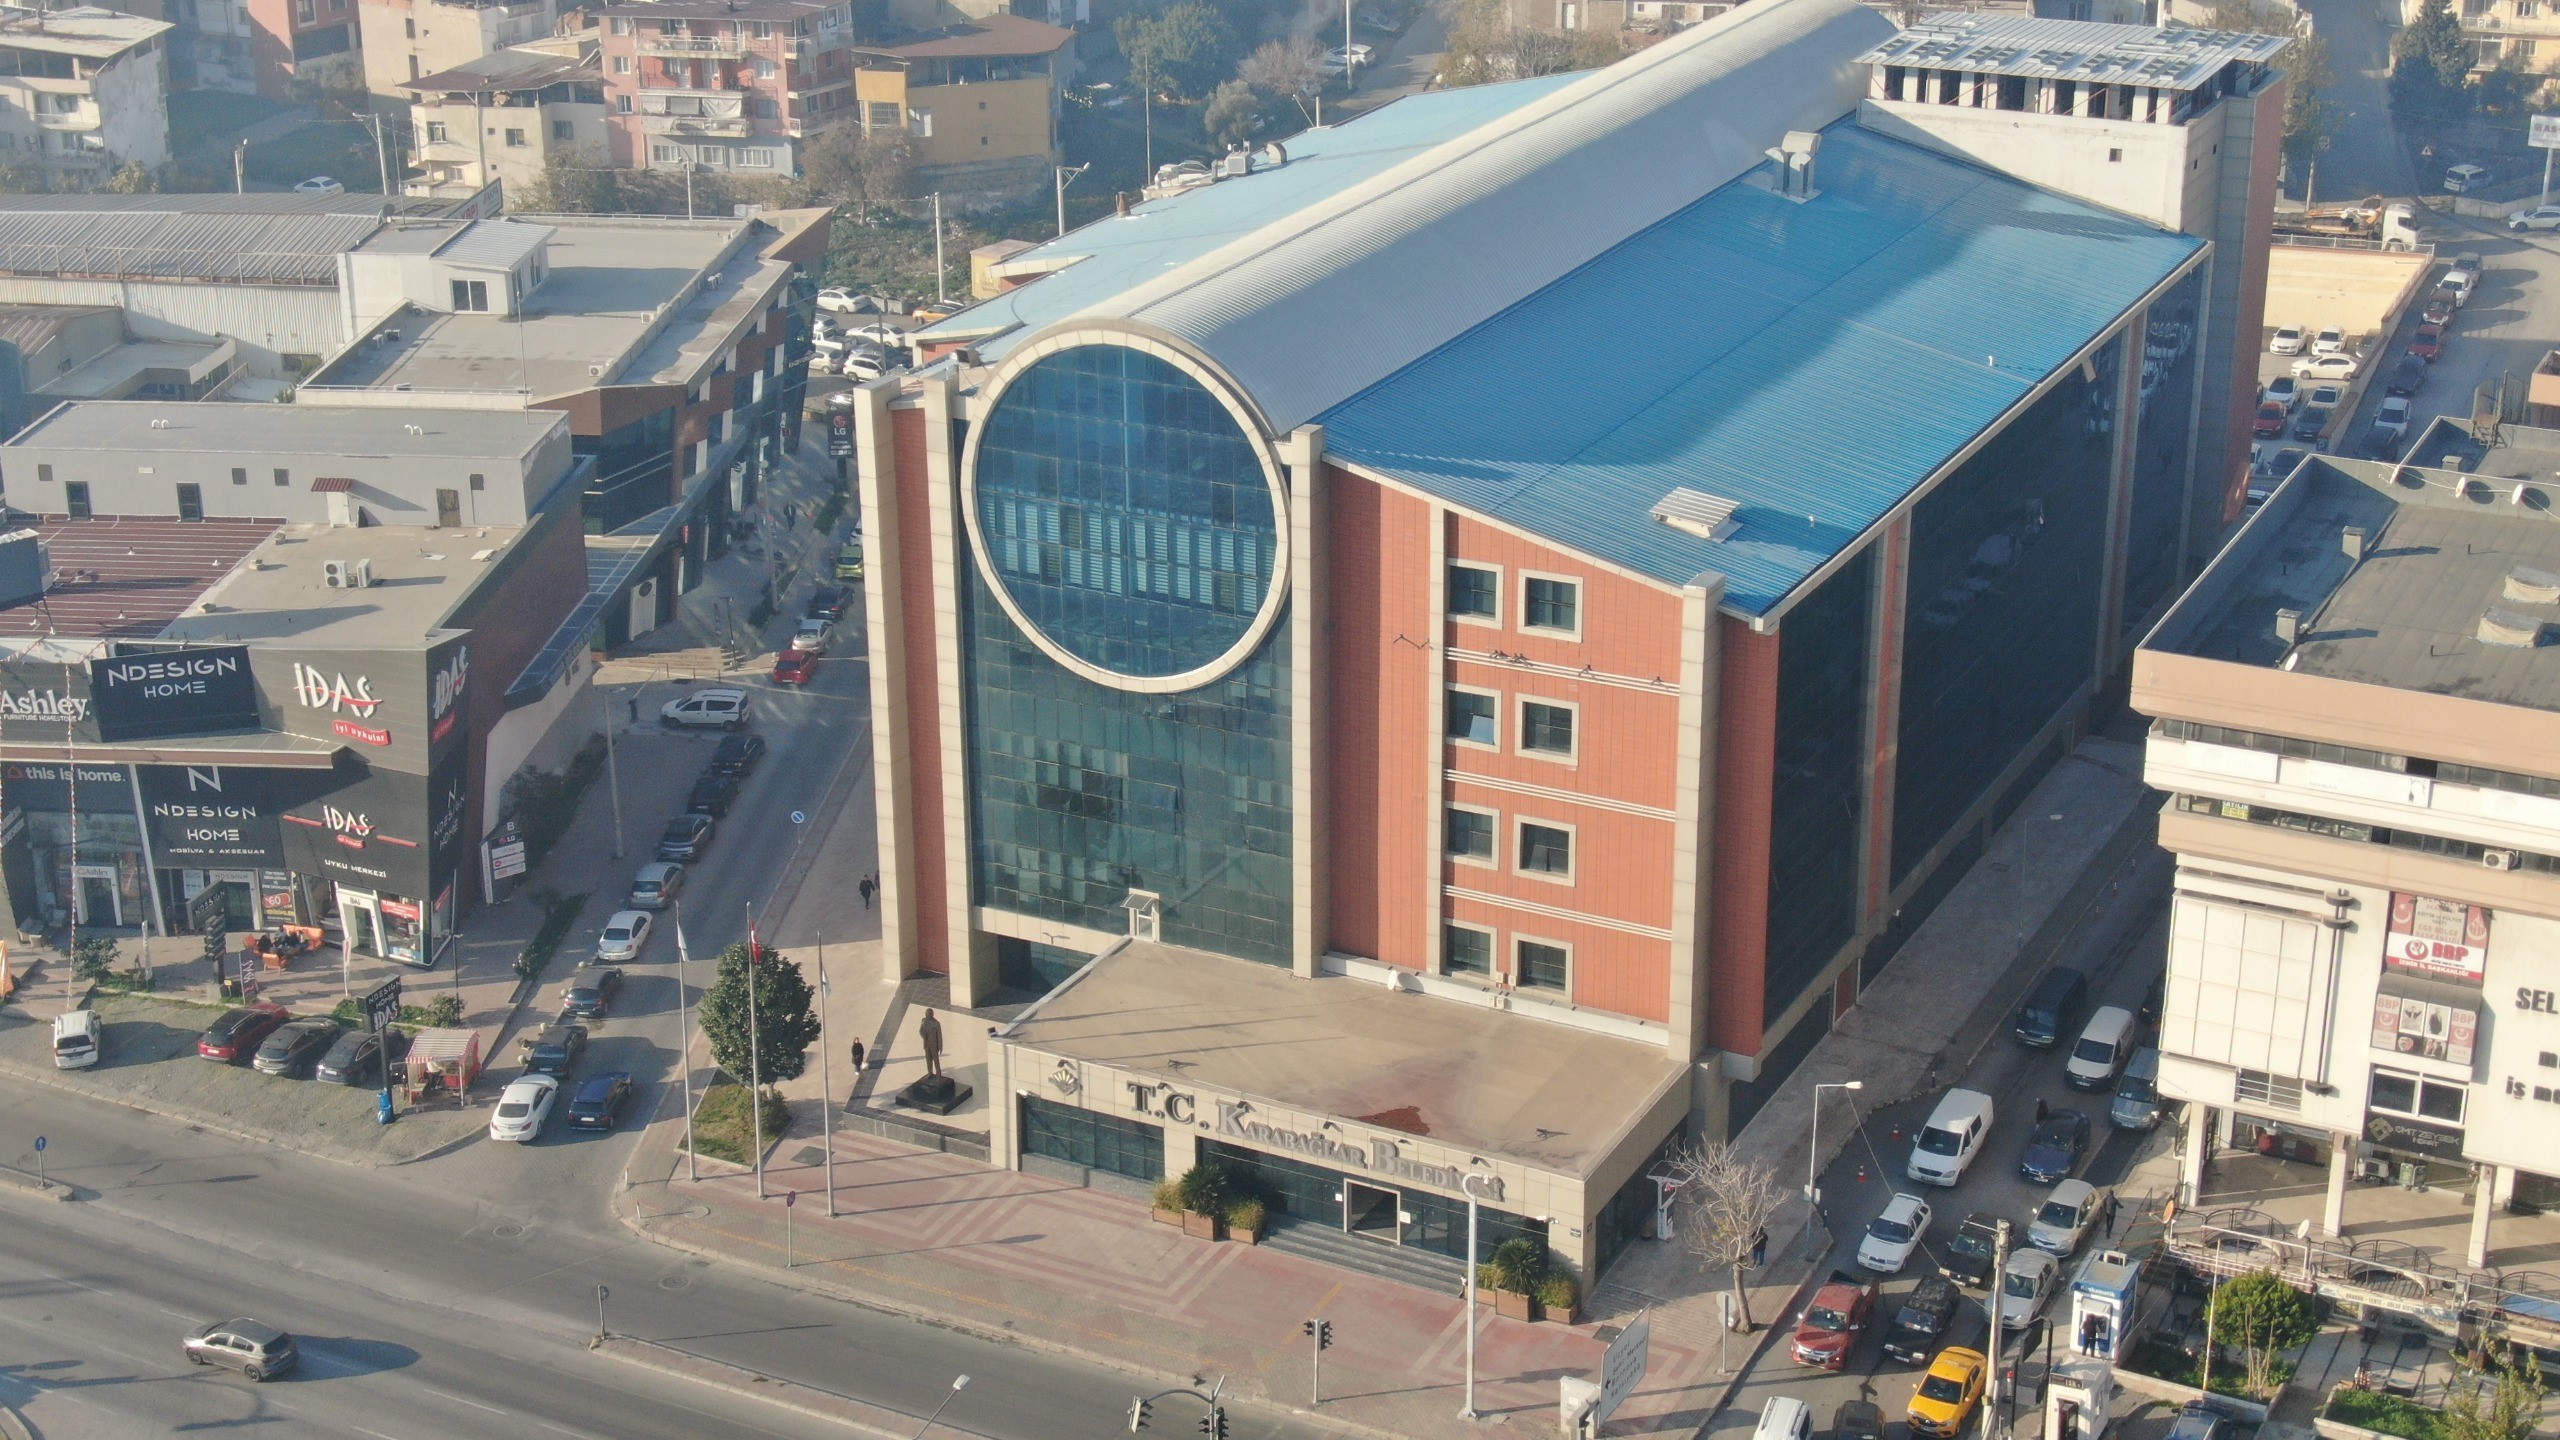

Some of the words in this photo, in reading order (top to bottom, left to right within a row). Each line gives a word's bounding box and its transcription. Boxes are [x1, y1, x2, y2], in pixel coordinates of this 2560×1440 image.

[834, 427, 846, 436] LG
[108, 656, 237, 687] NDESIGN
[144, 680, 207, 699] HOME
[26, 766, 55, 780] this
[60, 767, 72, 781] is
[154, 803, 257, 820] NDESIGN
[187, 828, 240, 841] HOME
[2431, 941, 2469, 962] BBP
